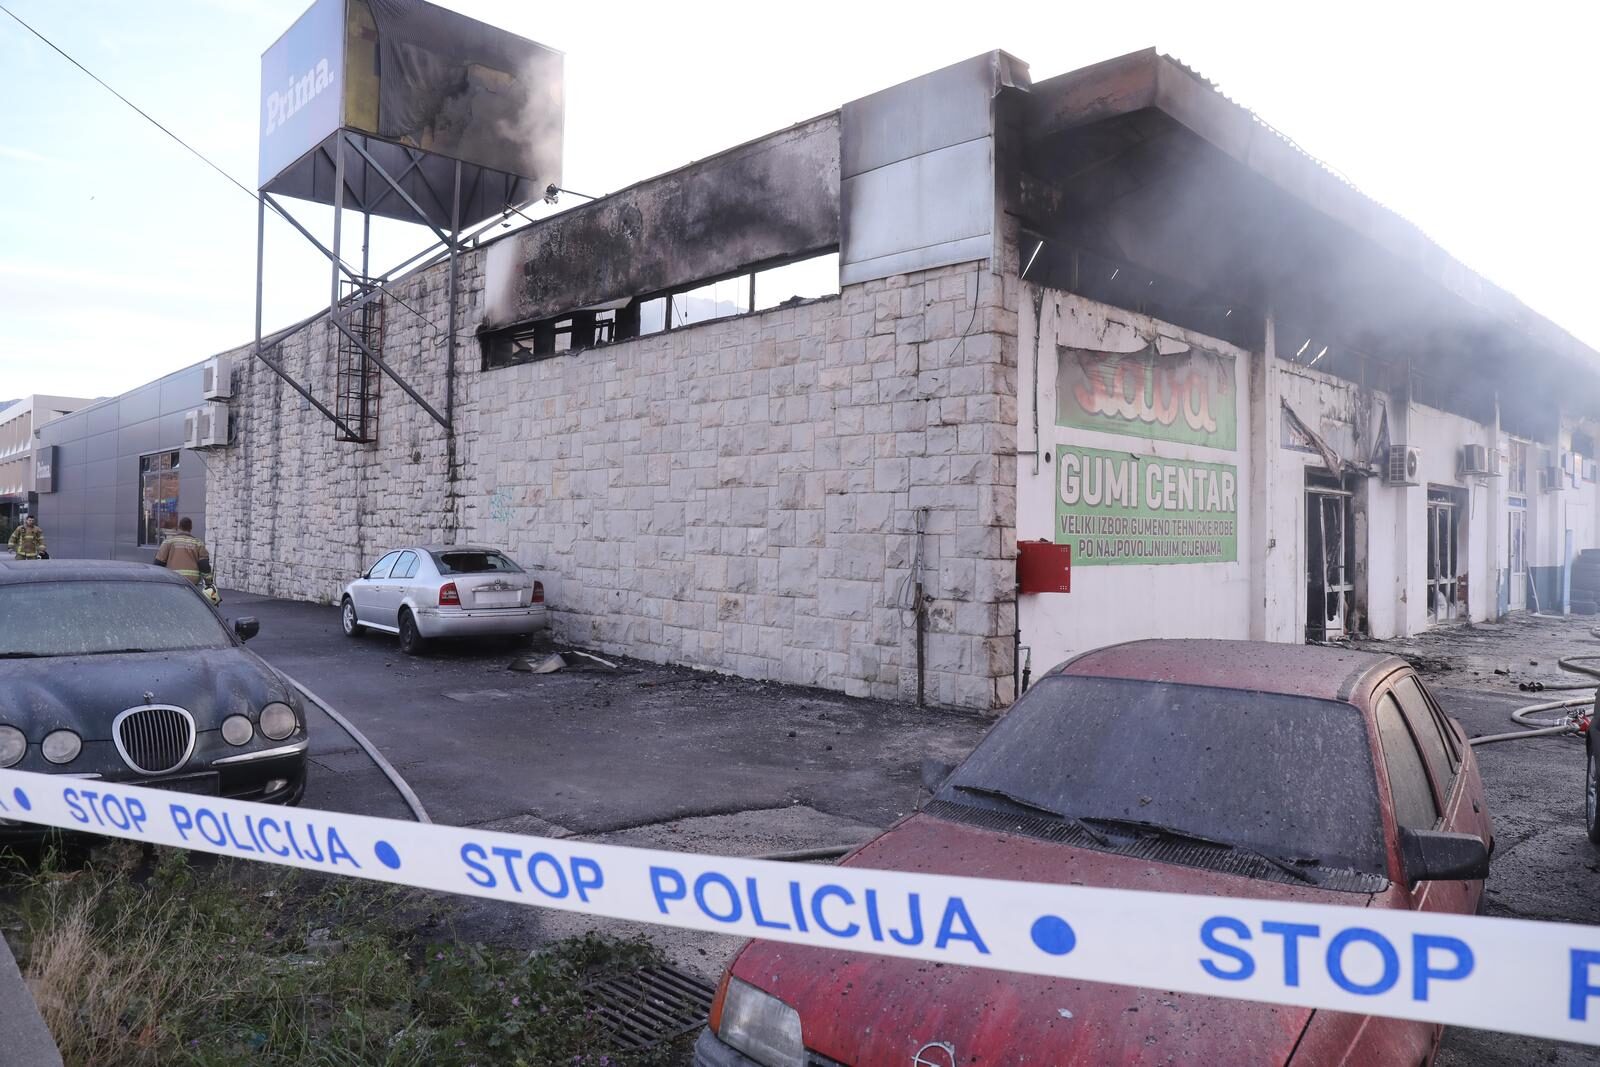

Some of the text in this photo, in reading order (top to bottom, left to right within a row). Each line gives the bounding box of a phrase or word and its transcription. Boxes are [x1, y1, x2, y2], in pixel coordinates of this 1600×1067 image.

[266, 58, 335, 136] Prima.
[1060, 452, 1236, 513] GUMI CENTAR
[1060, 515, 1095, 534] VELIKI
[1098, 517, 1129, 535] IZBOR
[1131, 518, 1170, 536] GUMENO
[1213, 520, 1233, 536] ROBE
[1079, 539, 1222, 557] PO NAJPOVOLJNIJIM CIJENAMA
[63, 787, 148, 833] STOP
[168, 803, 361, 869] POLICIJA
[459, 842, 606, 904] STOP
[648, 864, 991, 955] POLICIJA
[1199, 914, 1476, 1003] STOP
